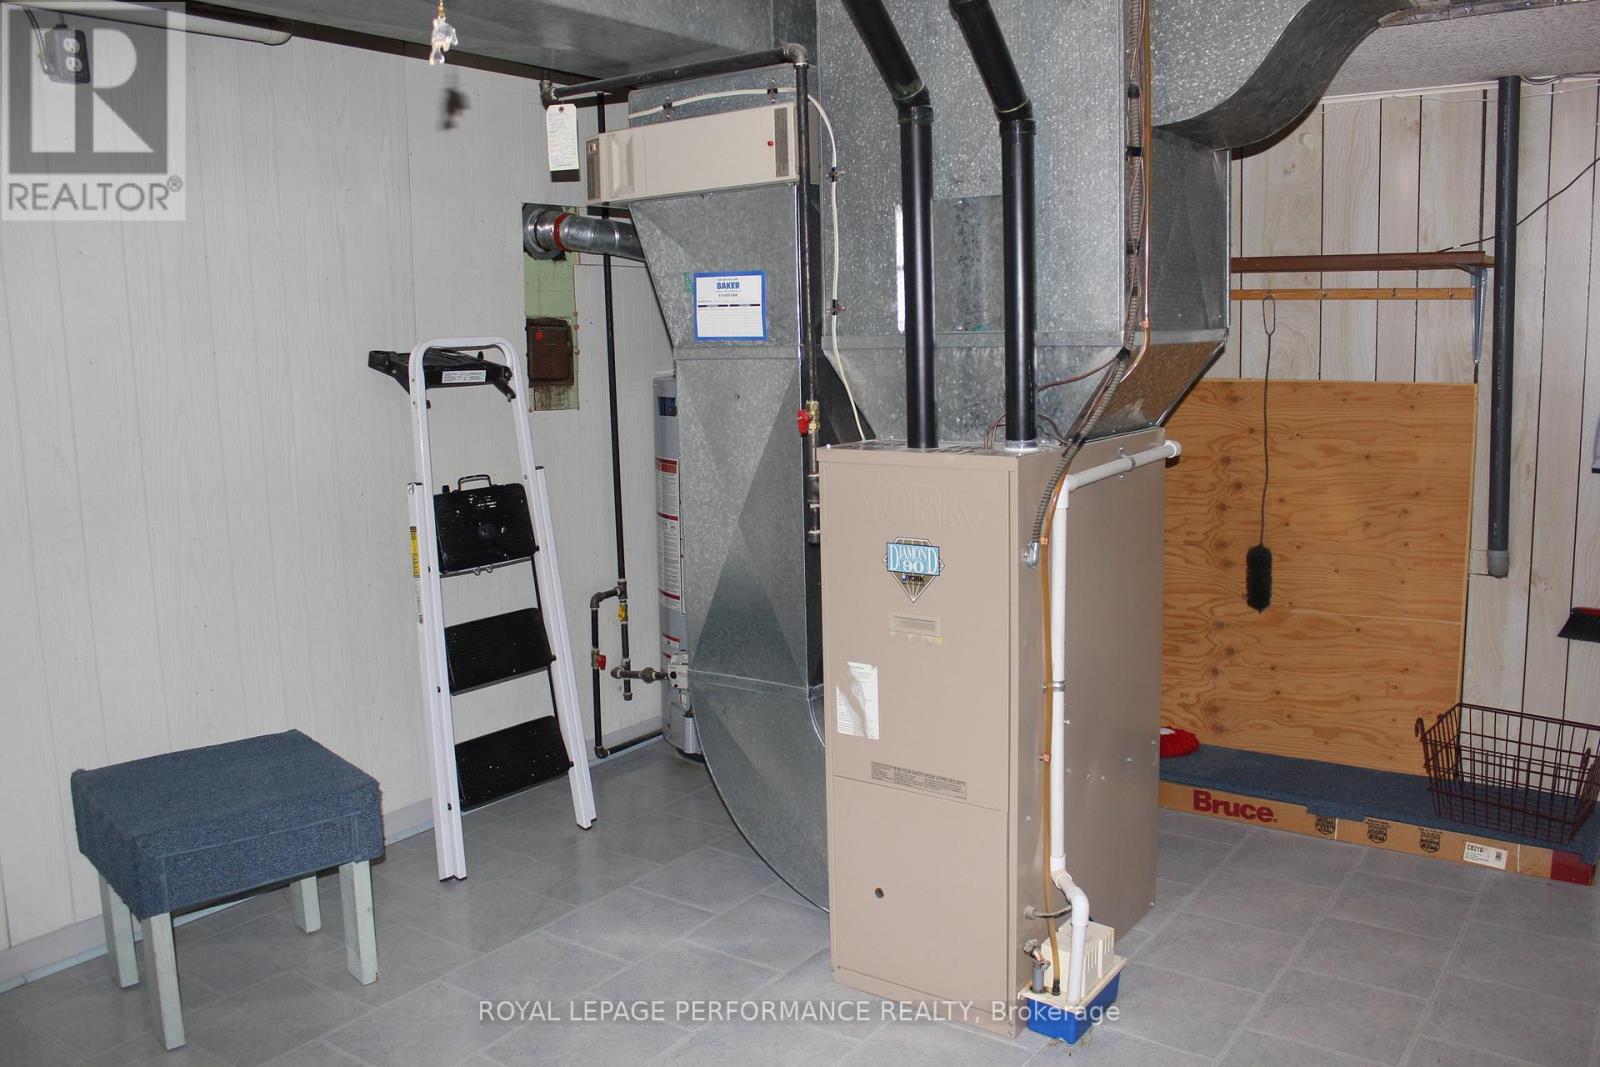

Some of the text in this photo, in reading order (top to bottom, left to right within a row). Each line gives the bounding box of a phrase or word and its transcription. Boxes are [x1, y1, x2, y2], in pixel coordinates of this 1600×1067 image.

[716, 281, 740, 290] BAKER
[889, 544, 938, 575] DIAMOND
[902, 560, 925, 573] 90
[908, 575, 925, 583] YORK
